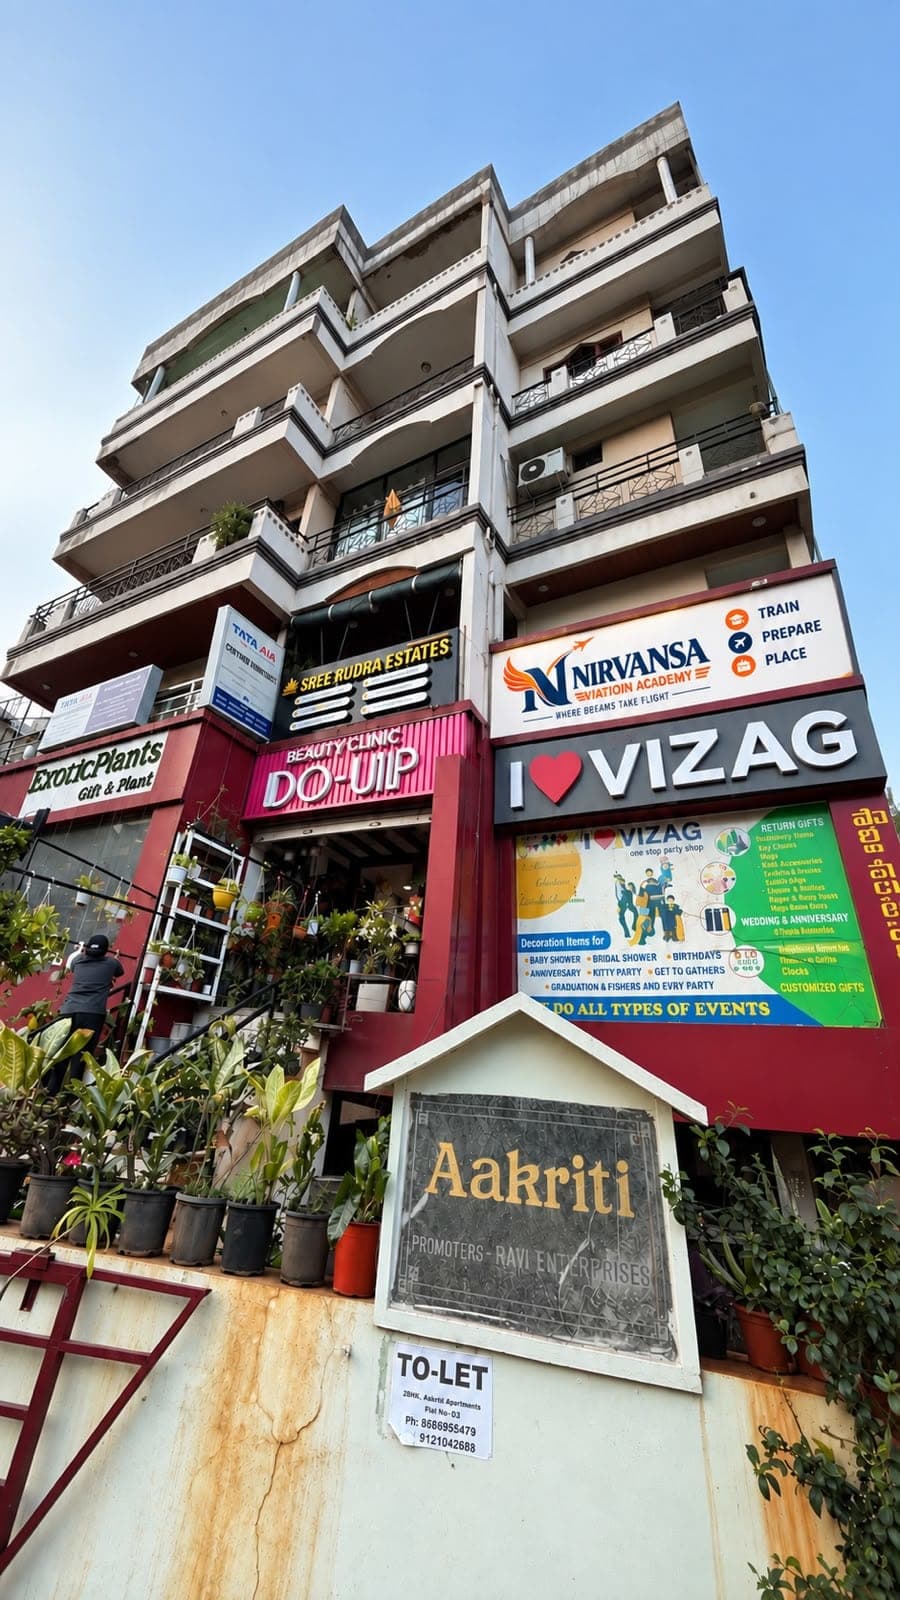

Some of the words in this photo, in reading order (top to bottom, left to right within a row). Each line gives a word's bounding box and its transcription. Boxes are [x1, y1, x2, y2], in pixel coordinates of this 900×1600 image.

[758, 600, 800, 618] TRAIN
[762, 620, 822, 642] PREPARE
[232, 623, 258, 650] TATA
[259, 646, 276, 662] AIA
[300, 672, 331, 692] SREE
[334, 657, 382, 683] RUDRA
[385, 637, 449, 669] ESTATES
[572, 638, 711, 690] NIRVANSA
[766, 647, 808, 666] PLACE
[637, 670, 692, 690] ACADEMY
[556, 708, 581, 720] WHERE
[618, 698, 638, 710] TAKE
[642, 692, 669, 705] FLIGHT
[287, 739, 347, 764] BEAUTY
[348, 728, 402, 752] CLINIC
[510, 761, 524, 810] I
[588, 710, 858, 798] VIZAG
[78, 784, 102, 801] Gift
[104, 781, 114, 795] &
[116, 772, 154, 792] Plant
[618, 822, 702, 847] VIZAG
[762, 820, 796, 832] RETURN
[798, 818, 824, 828] GIFTS
[646, 847, 662, 858] stop
[663, 846, 682, 856] party
[684, 844, 704, 854] shop
[741, 915, 780, 926] WEDDING
[782, 916, 788, 925] &
[790, 913, 848, 924] ANNIVERSARY
[521, 937, 565, 948] Decoration
[566, 936, 590, 947] Items
[592, 936, 605, 946] for
[530, 956, 548, 964] BABY
[550, 955, 581, 964] SHOWER
[592, 954, 620, 963] BRIDAL
[622, 953, 658, 962] SHOWER
[672, 952, 722, 961] BIRTHDAYS
[592, 968, 615, 977] KITTY
[616, 968, 642, 976] PARTY
[654, 967, 670, 976] GET
[671, 966, 684, 976] TO
[685, 966, 726, 976] GATHERS
[551, 982, 600, 992] GRADUATION
[607, 982, 641, 991] FISHERS
[642, 982, 660, 990] AND
[662, 982, 685, 990] EVRY
[686, 980, 715, 990] PARTY
[780, 982, 836, 993] CUSTOMIZED
[840, 982, 864, 993] GIFTS
[554, 1002, 574, 1015] DO
[577, 1002, 607, 1016] ALL
[611, 1002, 662, 1016] TYPES
[667, 1002, 690, 1016] OF
[695, 1002, 770, 1016] EVENTS
[425, 1141, 635, 1218] Aakriti
[411, 1234, 484, 1262] PROMOTERS
[496, 1245, 530, 1271] RAVI
[538, 1252, 650, 1288] ENTERPRISES
[397, 1352, 488, 1391] TO-LET
[405, 1415, 419, 1427] Ph:
[419, 1432, 476, 1453] 9121042688
